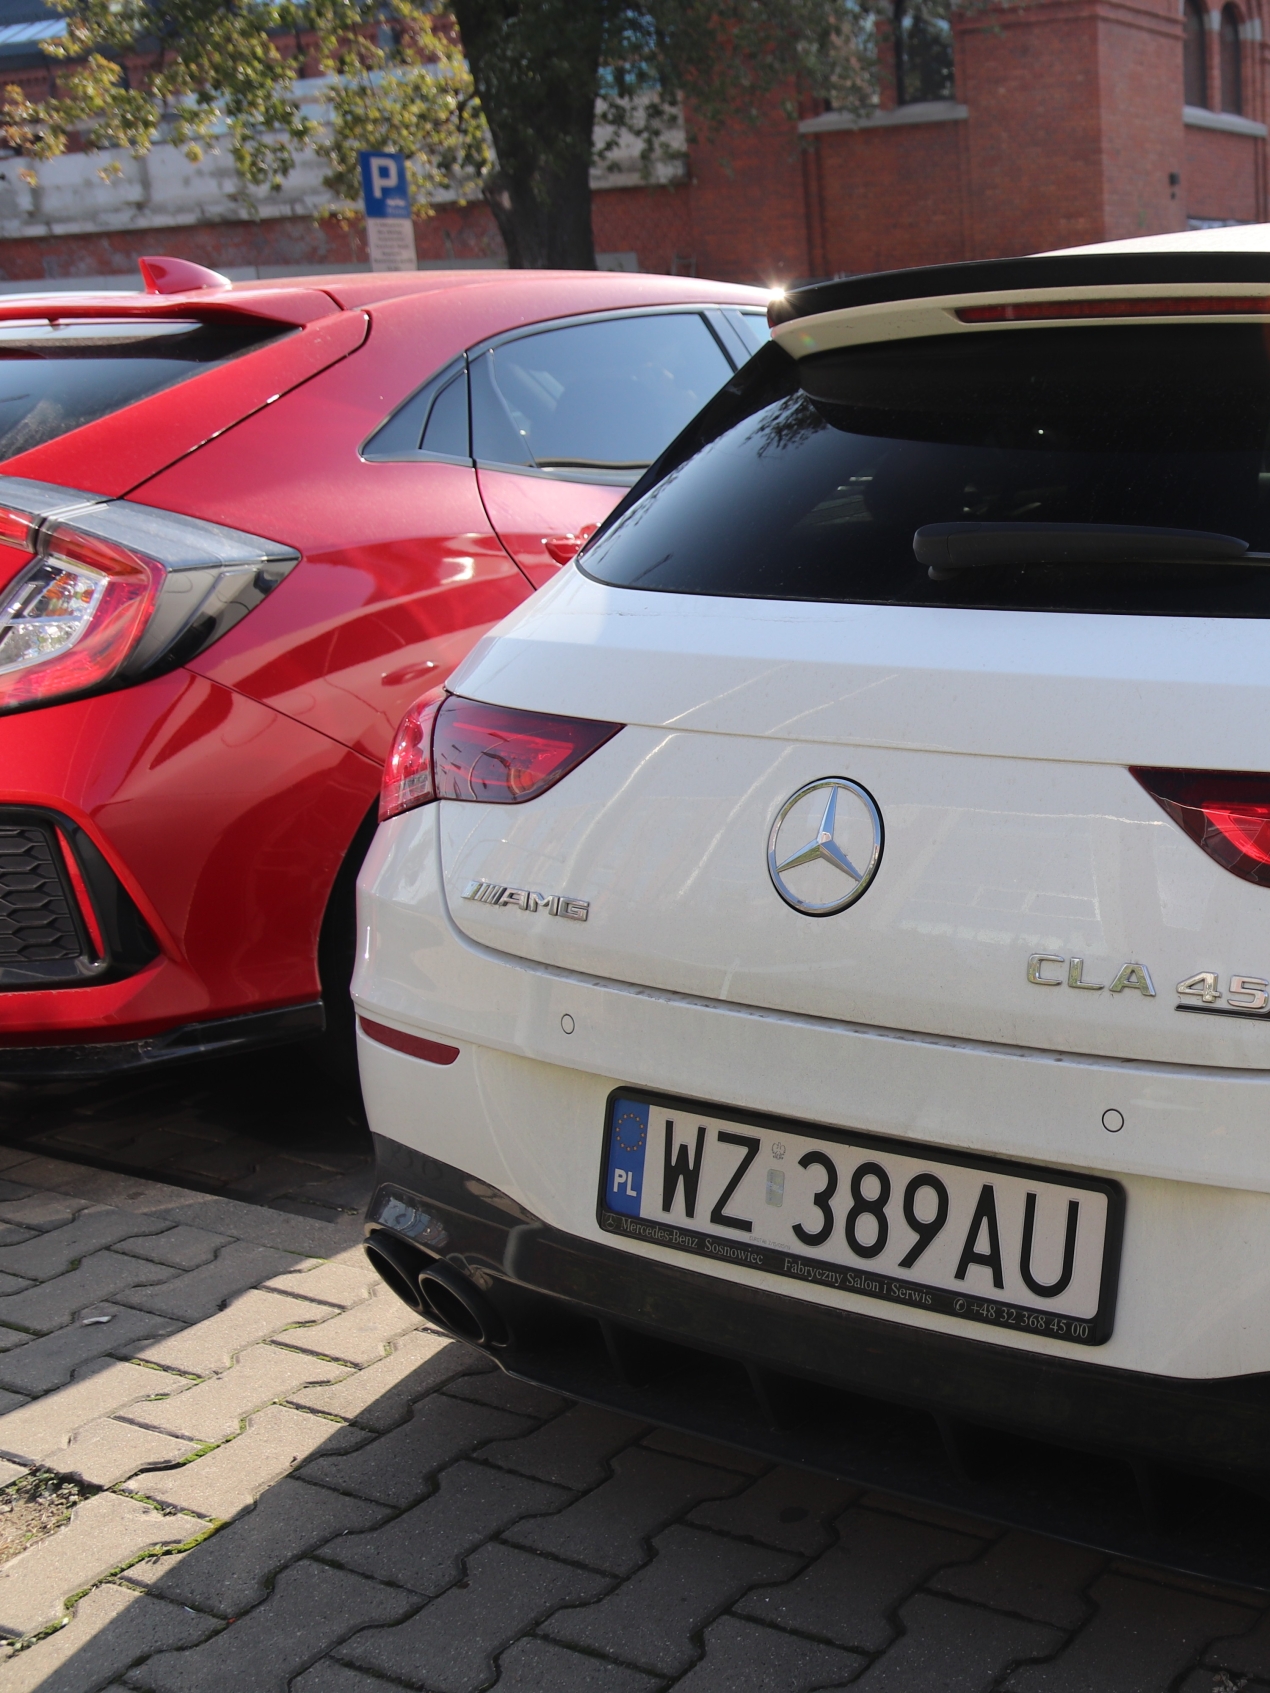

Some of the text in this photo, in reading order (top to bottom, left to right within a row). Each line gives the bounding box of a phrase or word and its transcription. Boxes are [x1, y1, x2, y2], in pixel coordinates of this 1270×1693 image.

[369, 156, 399, 199] P
[1027, 953, 1157, 997] CLA
[1175, 970, 1270, 1010] 45
[613, 1168, 638, 1198] PL
[661, 1119, 1081, 1298] WZ 389AU
[620, 1217, 698, 1249] Mercedes-Benz
[704, 1238, 764, 1265] Sosnowiec
[783, 1257, 932, 1304] Fabryczny Salon i Serwis
[970, 1302, 1089, 1338] +48 32 368 45 00
